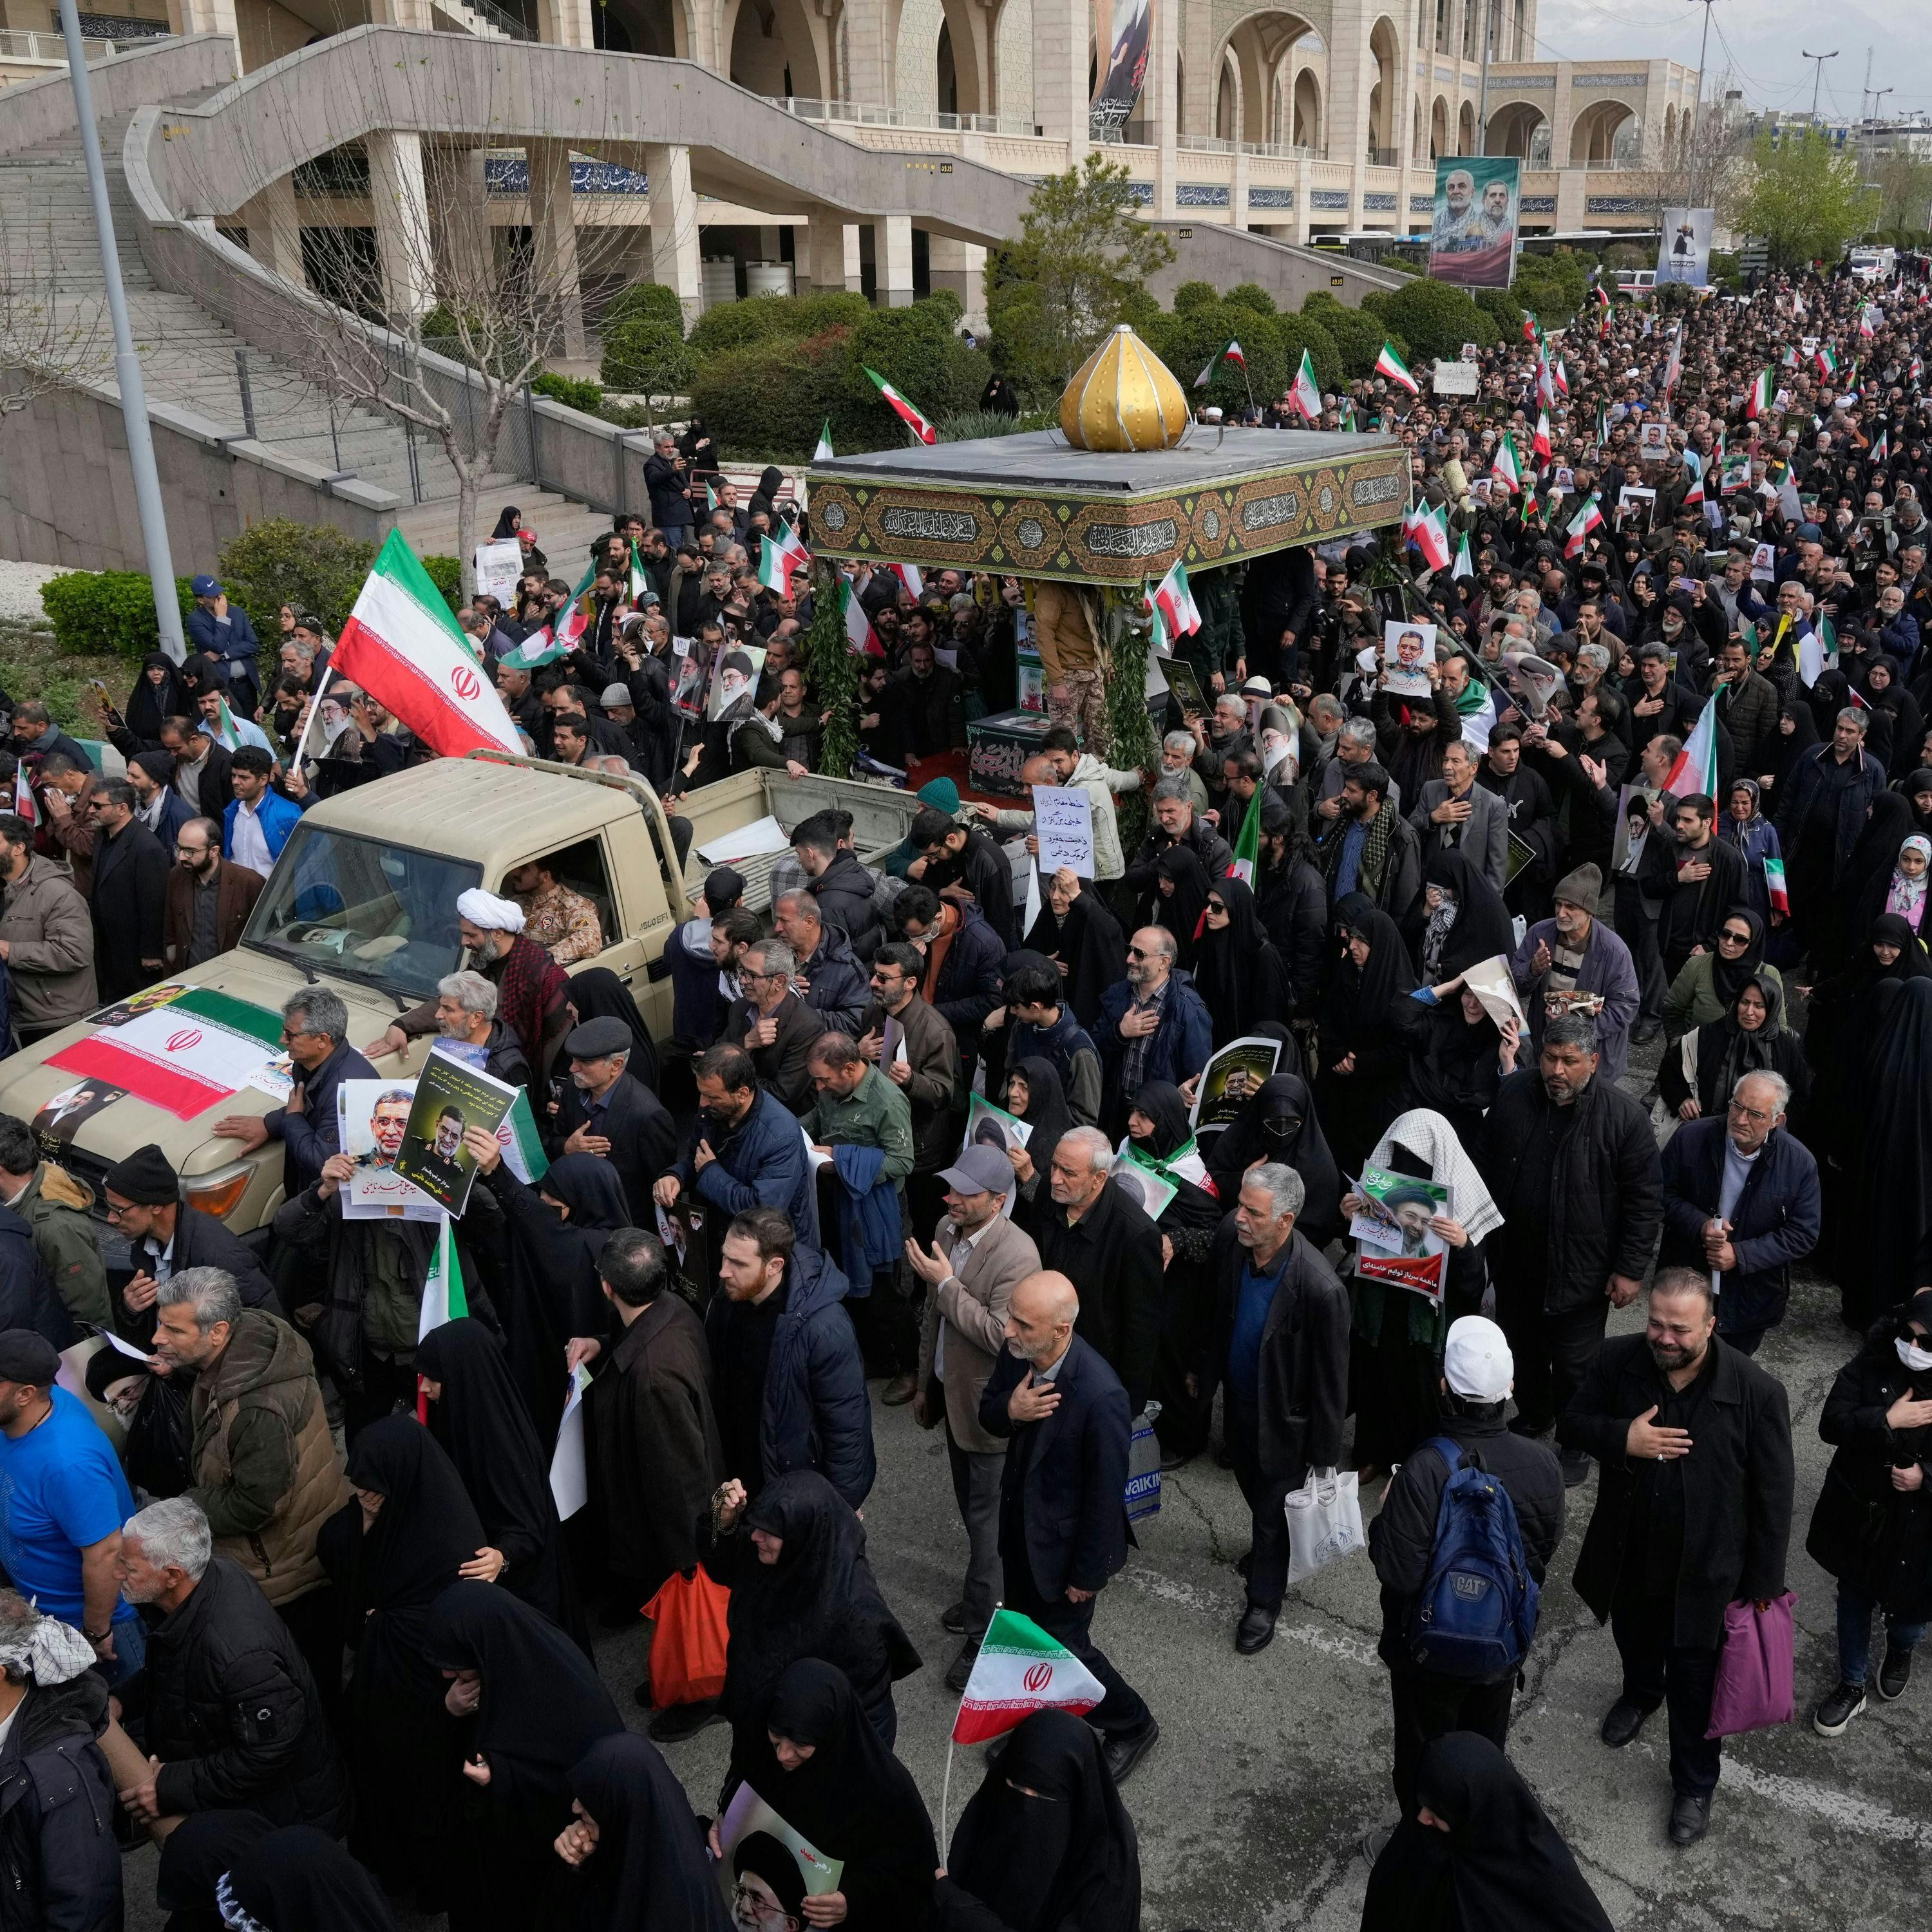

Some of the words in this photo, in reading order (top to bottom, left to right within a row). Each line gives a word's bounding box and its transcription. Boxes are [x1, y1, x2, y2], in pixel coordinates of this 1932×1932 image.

[1068, 797, 1084, 808] خط
[1065, 814, 1082, 827] خیلی
[1050, 845, 1070, 857] دشمن
[1388, 1268, 1403, 1276] توایم
[1403, 1271, 1419, 1280] سرباز
[1456, 1577, 1481, 1596] CAT
[800, 1848, 816, 1863] شهید
